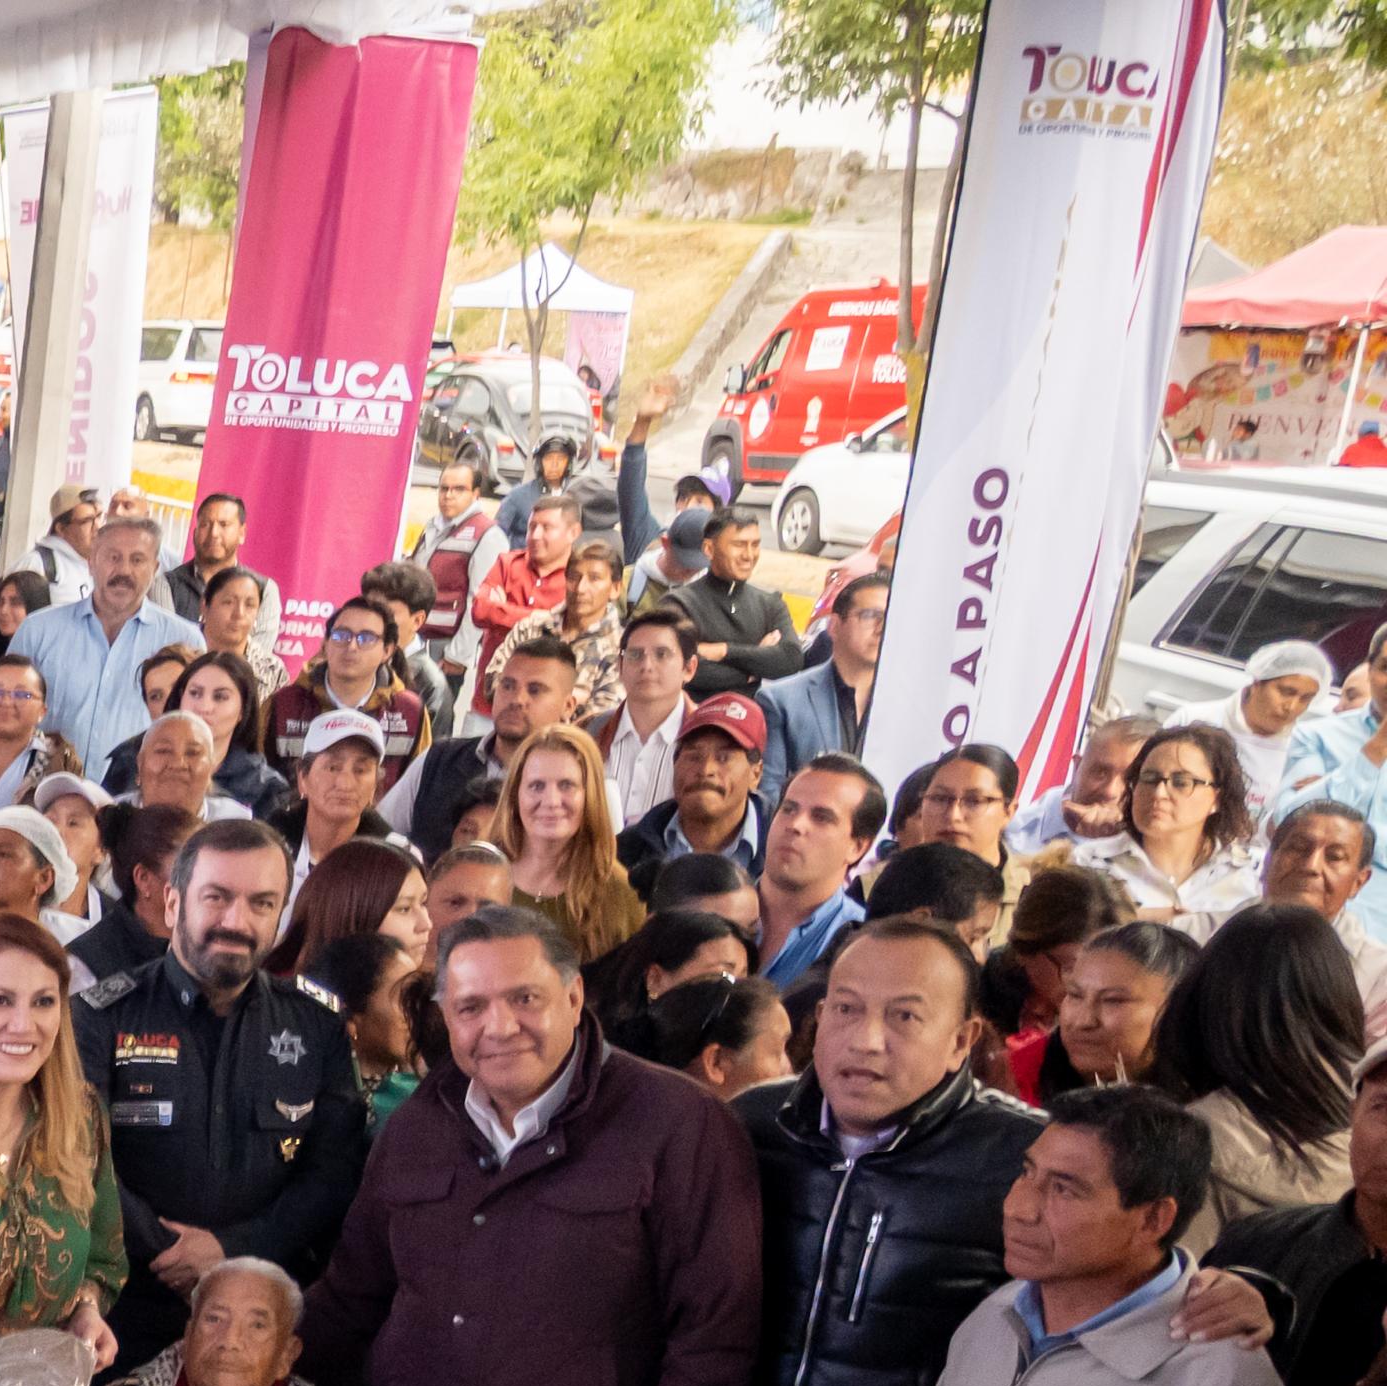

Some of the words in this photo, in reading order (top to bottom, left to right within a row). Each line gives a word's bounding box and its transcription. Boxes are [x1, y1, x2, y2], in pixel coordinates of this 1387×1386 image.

[227, 344, 413, 401] TOLUCA
[233, 395, 395, 424] CAPITAL
[955, 467, 1010, 632] PASO
[284, 598, 334, 619] PASO
[950, 645, 983, 688] A
